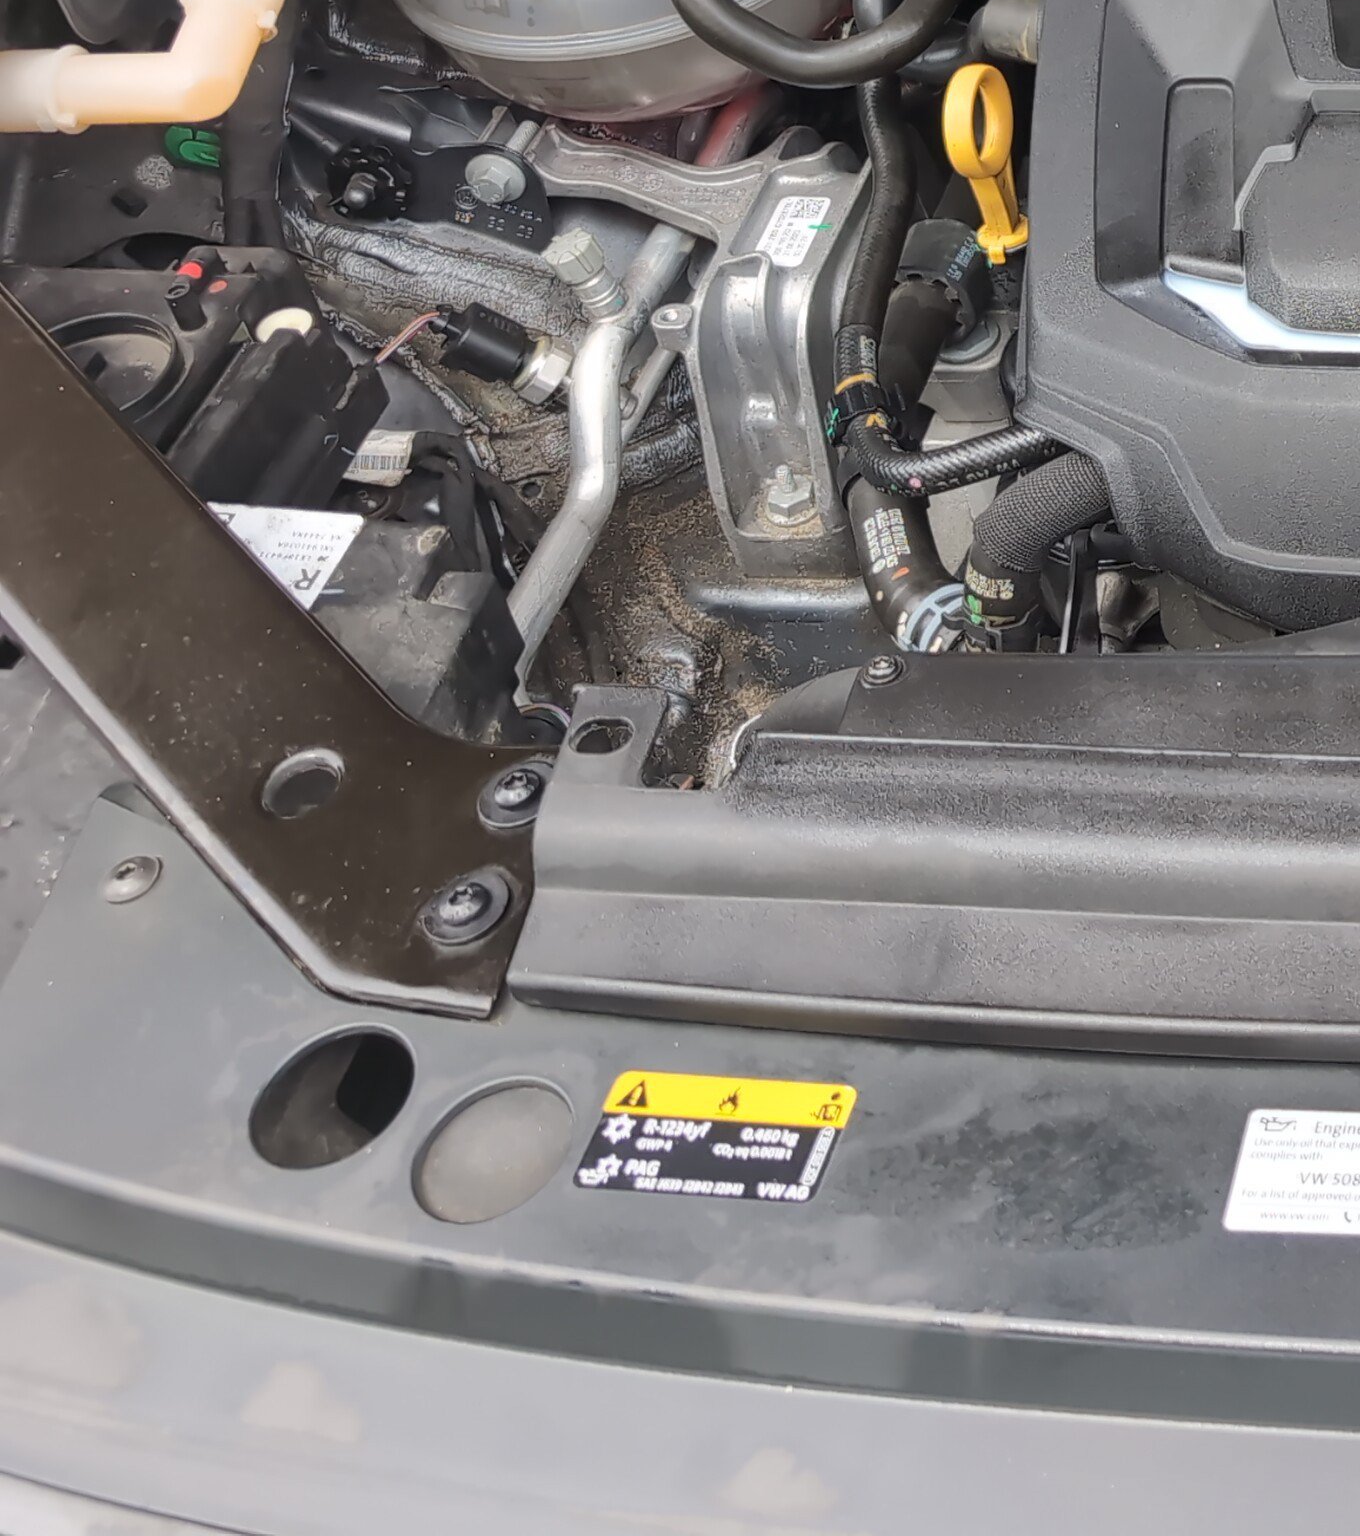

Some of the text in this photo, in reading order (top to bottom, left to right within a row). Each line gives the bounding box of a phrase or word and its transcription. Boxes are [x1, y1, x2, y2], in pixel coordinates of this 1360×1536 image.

[294, 568, 322, 591] R
[642, 1117, 712, 1142] R-1234yf
[781, 1129, 800, 1148] kg
[635, 1137, 664, 1151] GWP
[1254, 1137, 1269, 1147] Use
[1299, 1139, 1313, 1148] oil
[1315, 1138, 1337, 1149] that
[1250, 1151, 1323, 1161] complies with
[623, 1158, 661, 1176] PAG
[1300, 1172, 1329, 1185] VW
[757, 1181, 810, 1201] VW AG
[1269, 1189, 1285, 1199] list
[1301, 1191, 1351, 1202] approved
[1260, 1211, 1329, 1221] www.vw.com
